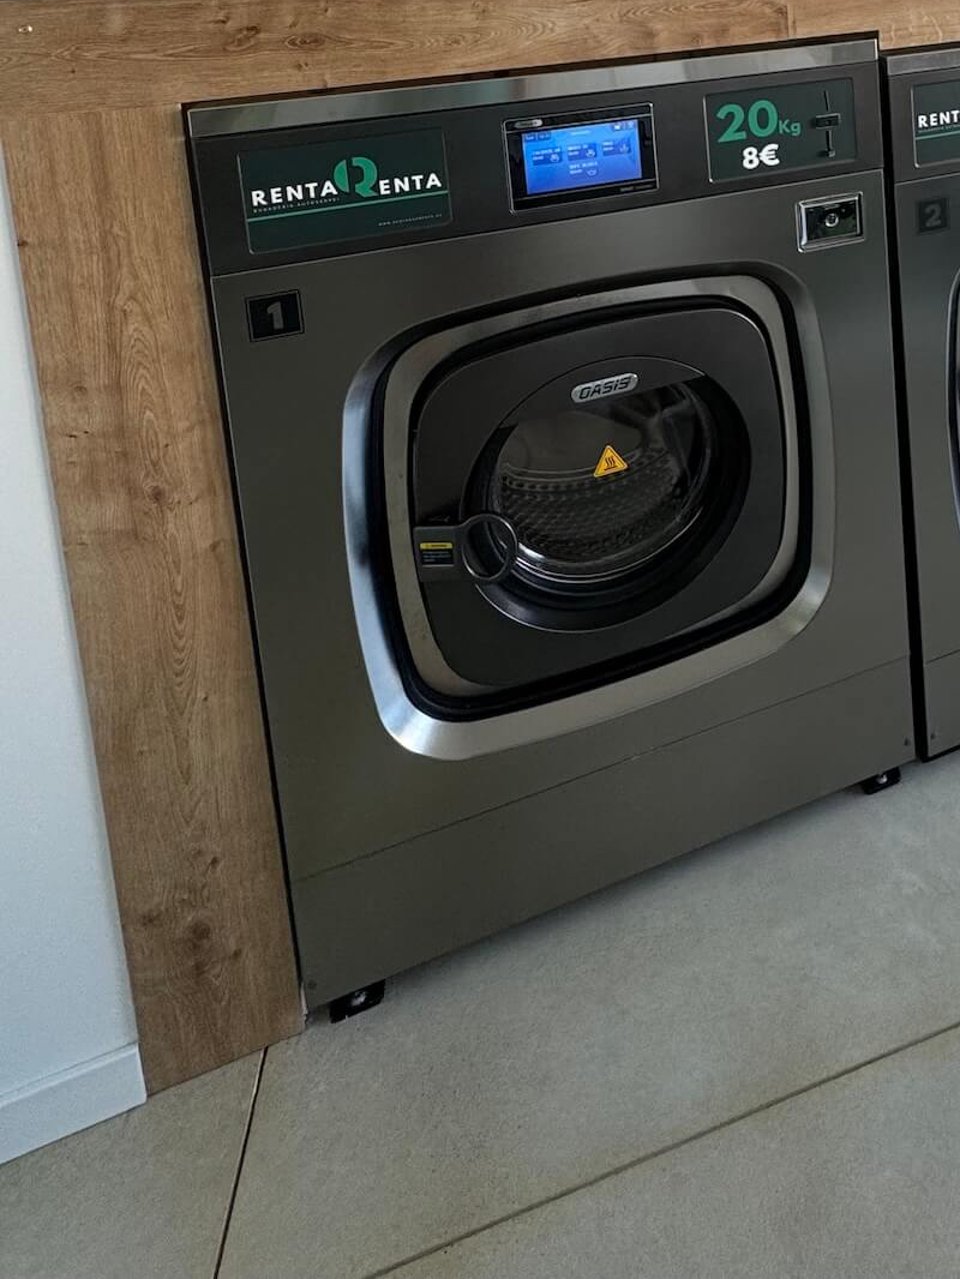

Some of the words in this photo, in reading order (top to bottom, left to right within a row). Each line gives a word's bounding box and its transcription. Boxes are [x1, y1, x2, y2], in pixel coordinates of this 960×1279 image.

[742, 143, 780, 169] 8€
[925, 204, 942, 227] 2
[267, 301, 284, 329] 1
[579, 376, 632, 400] OASIS
